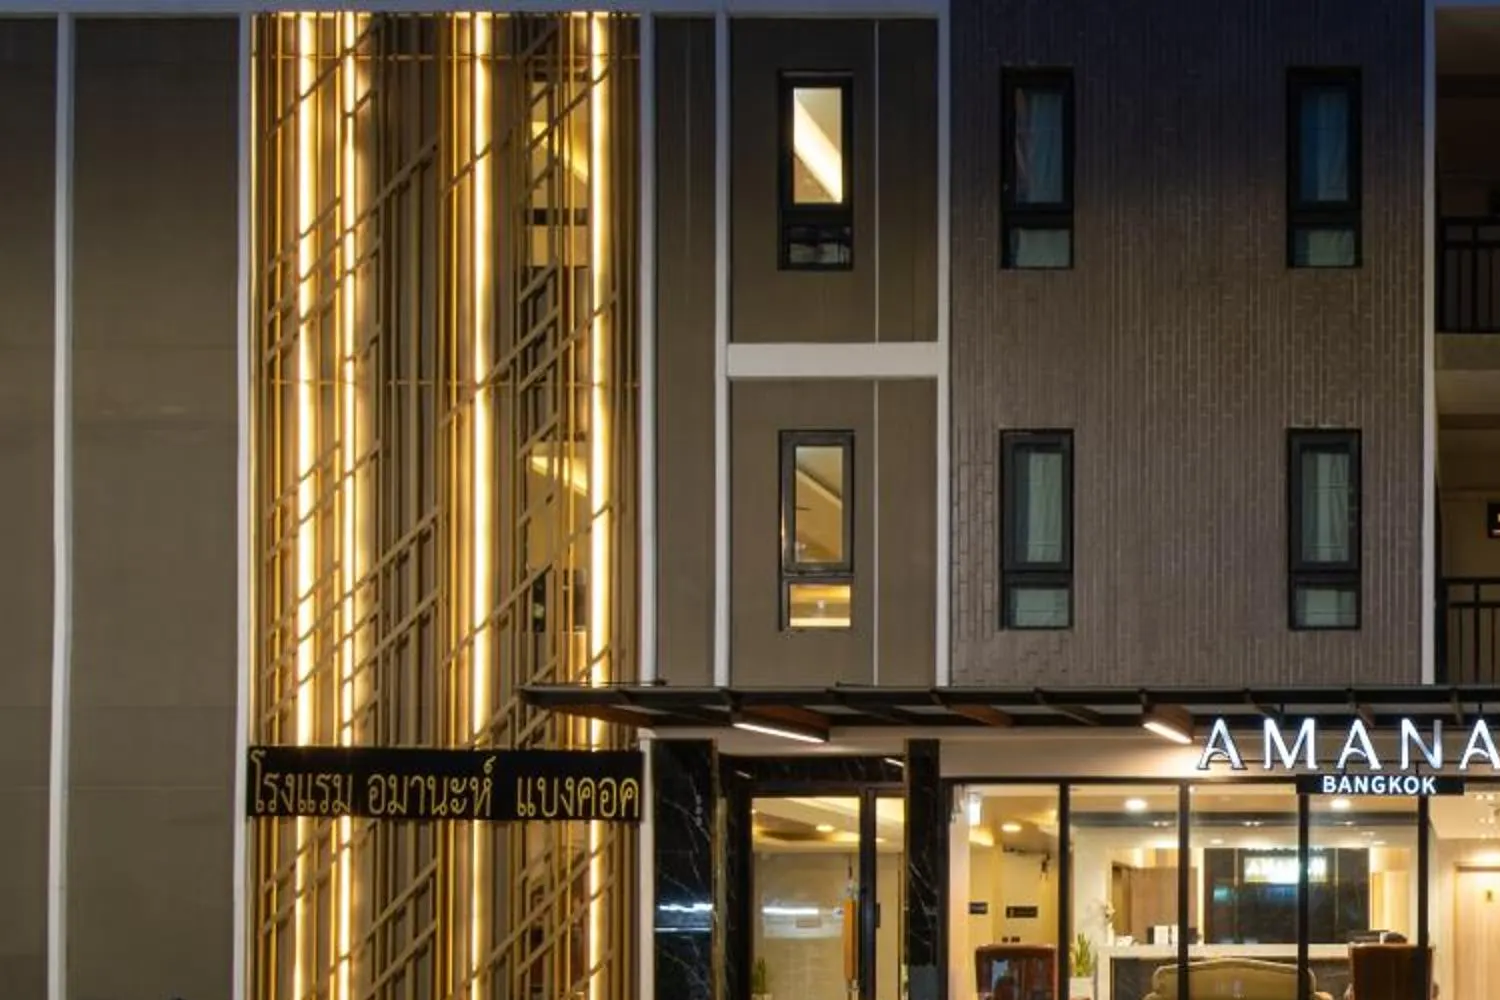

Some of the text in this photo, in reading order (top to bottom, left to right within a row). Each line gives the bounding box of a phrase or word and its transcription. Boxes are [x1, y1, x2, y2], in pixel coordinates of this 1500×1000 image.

[249, 749, 640, 818] โรงแรม อมานะห์ แบงคอค
[1322, 775, 1438, 795] BANGKOK
